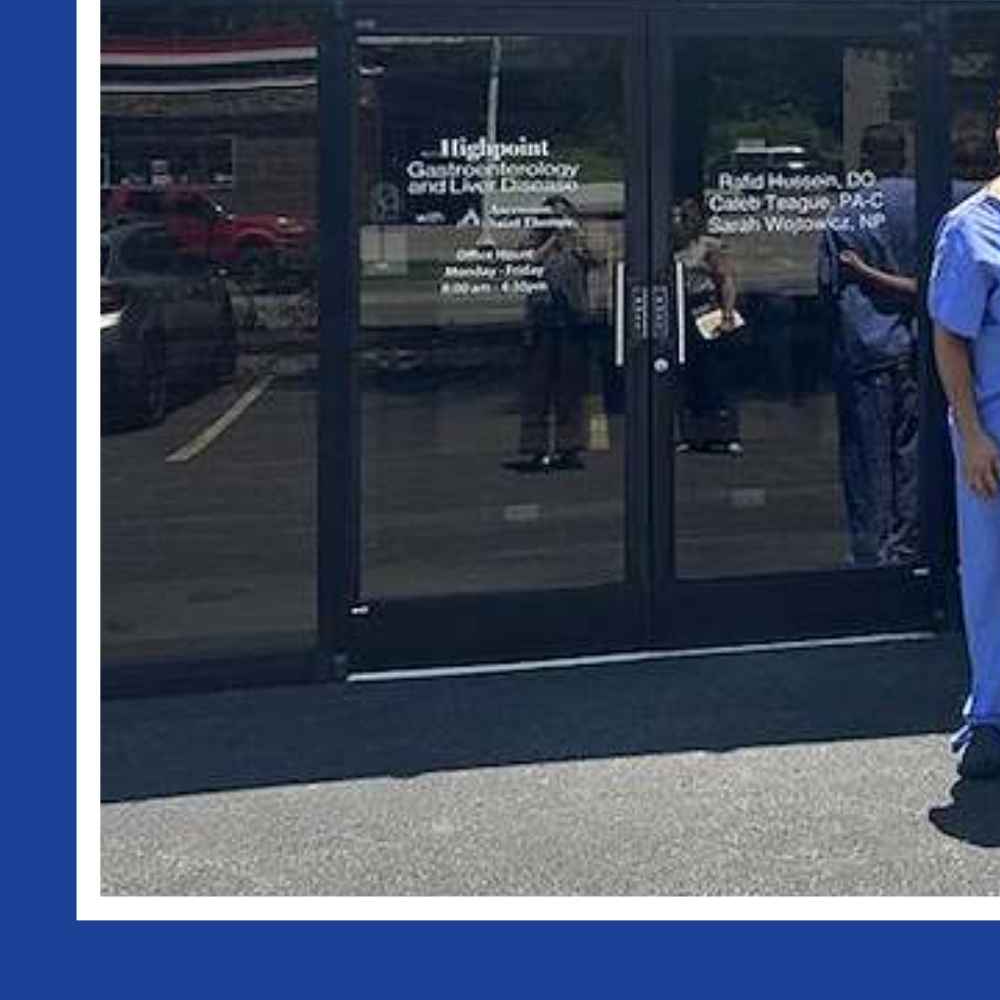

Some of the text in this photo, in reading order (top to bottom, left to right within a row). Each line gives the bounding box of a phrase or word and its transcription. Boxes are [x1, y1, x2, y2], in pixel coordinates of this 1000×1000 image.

[439, 135, 550, 161] Highpoint
[405, 161, 580, 179] Gastroenterology
[846, 170, 876, 187] DO
[406, 178, 447, 194] and
[450, 177, 496, 194] Liver
[708, 194, 762, 212] Caleb
[839, 192, 885, 209] PA-C
[859, 213, 887, 230] NP
